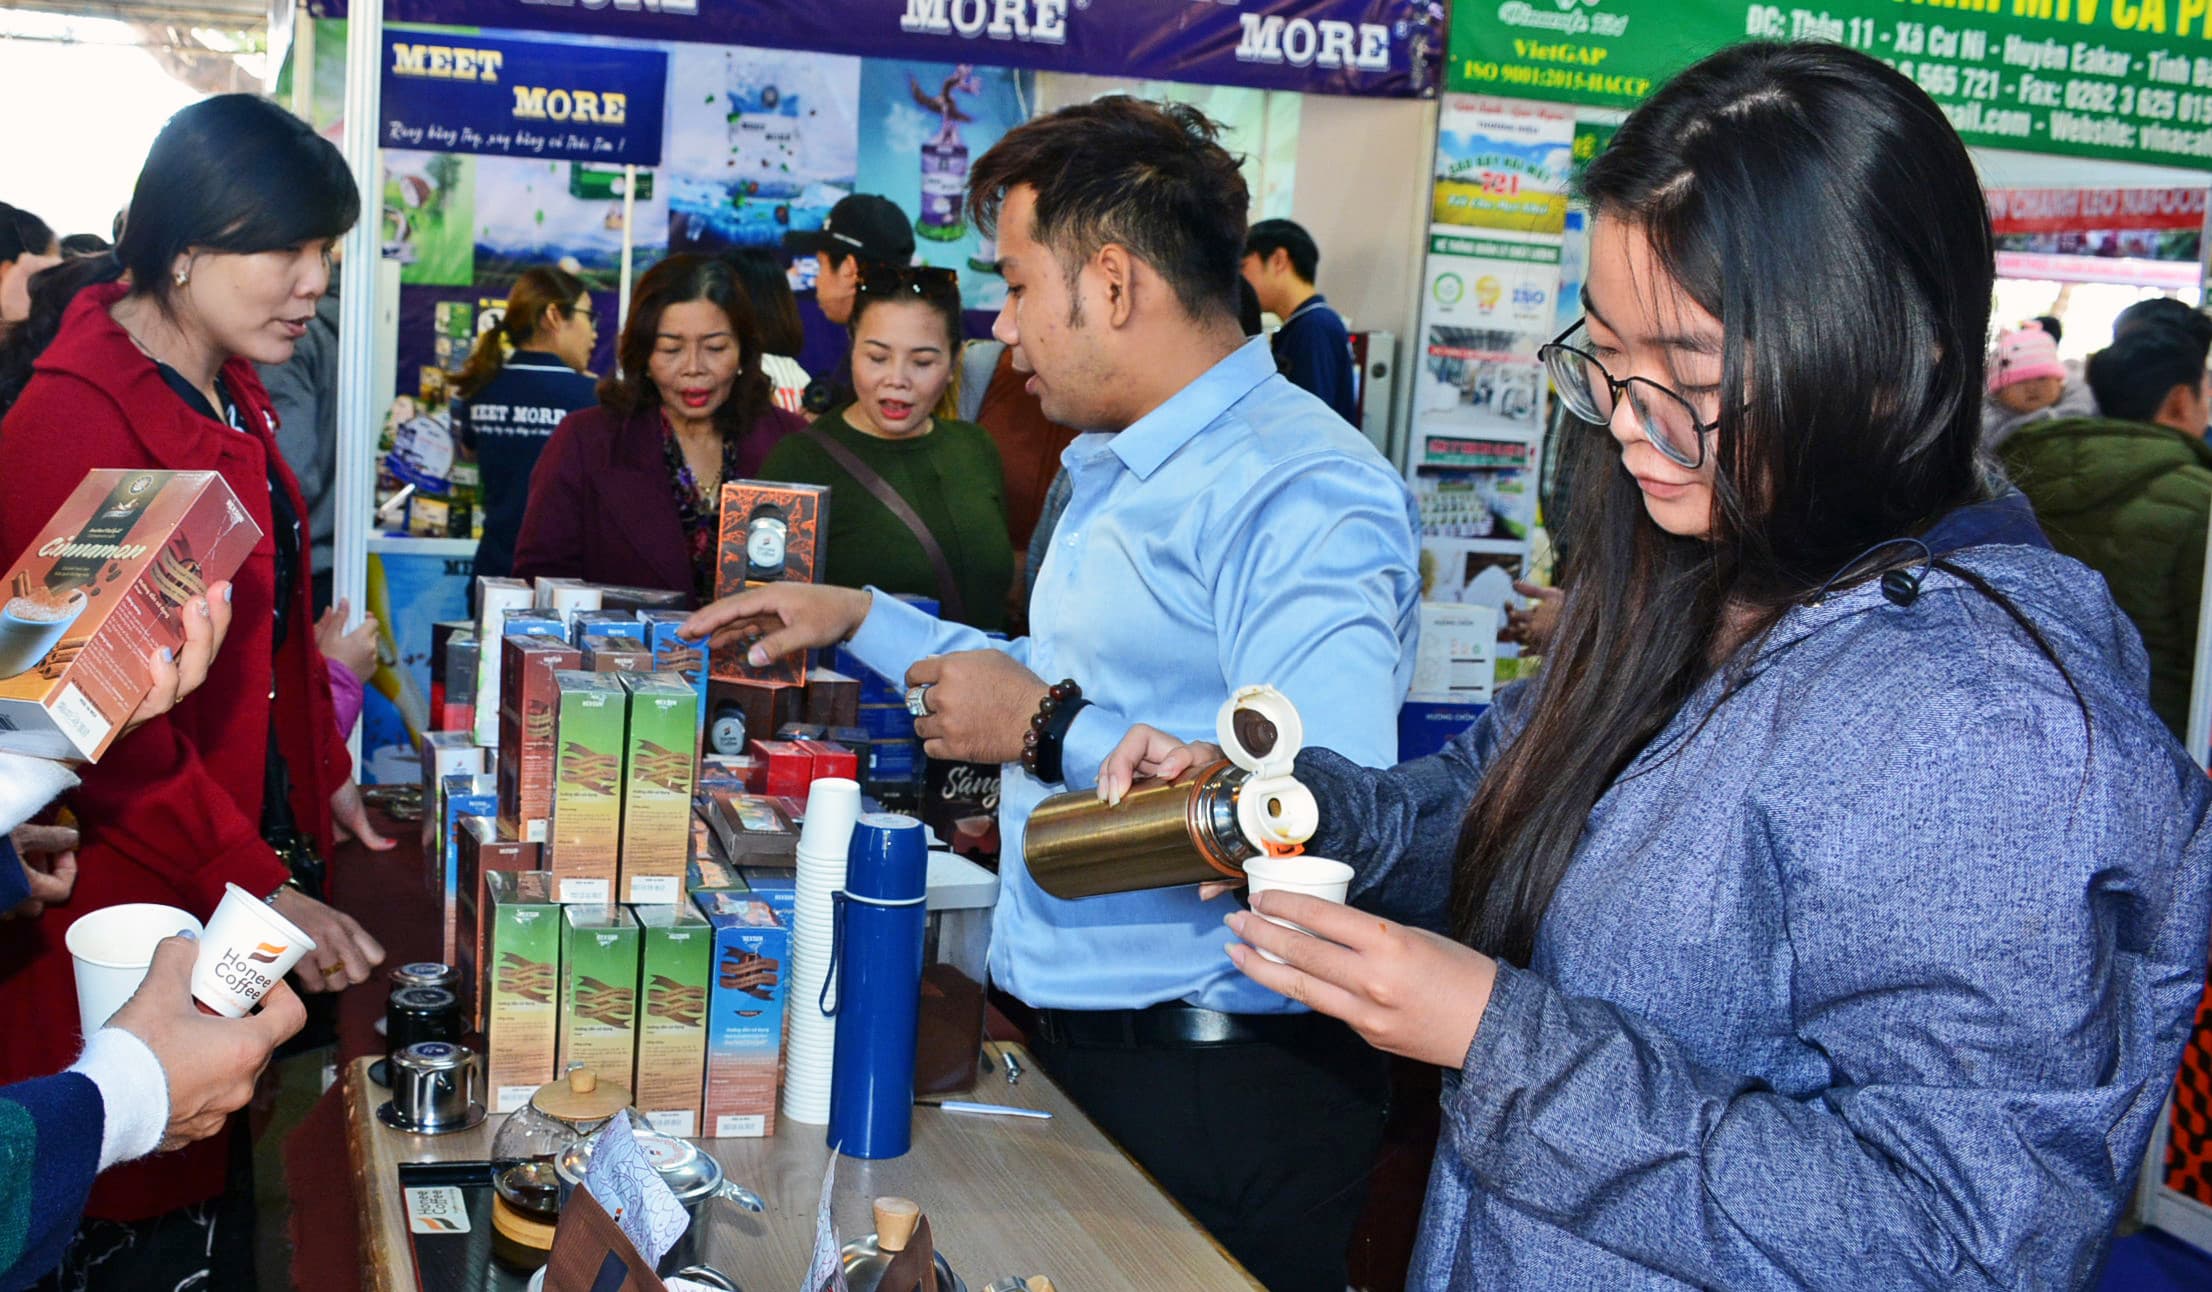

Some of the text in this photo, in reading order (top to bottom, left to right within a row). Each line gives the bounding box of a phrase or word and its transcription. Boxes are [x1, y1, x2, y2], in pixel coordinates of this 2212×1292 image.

[900, 0, 1066, 45] MORE
[1849, 17, 1874, 48] 11
[1235, 13, 1390, 72] MORE
[1514, 39, 1608, 66] VietGAP
[392, 43, 503, 83] MEET
[1464, 60, 1498, 81] ISO
[513, 86, 627, 125] MORE
[1961, 67, 2000, 100] 721
[2018, 73, 2063, 107] Fax:
[2118, 85, 2135, 116] 3
[2136, 87, 2176, 121] 625
[2050, 110, 2136, 148] Website:
[1480, 169, 1520, 198] 721
[38, 535, 148, 560] Cinnamon
[941, 765, 1000, 809] Sáng
[215, 962, 261, 1000] Coffee
[223, 946, 272, 988] Honee
[416, 1189, 432, 1215] Honee
[430, 1189, 448, 1215] Coffee
